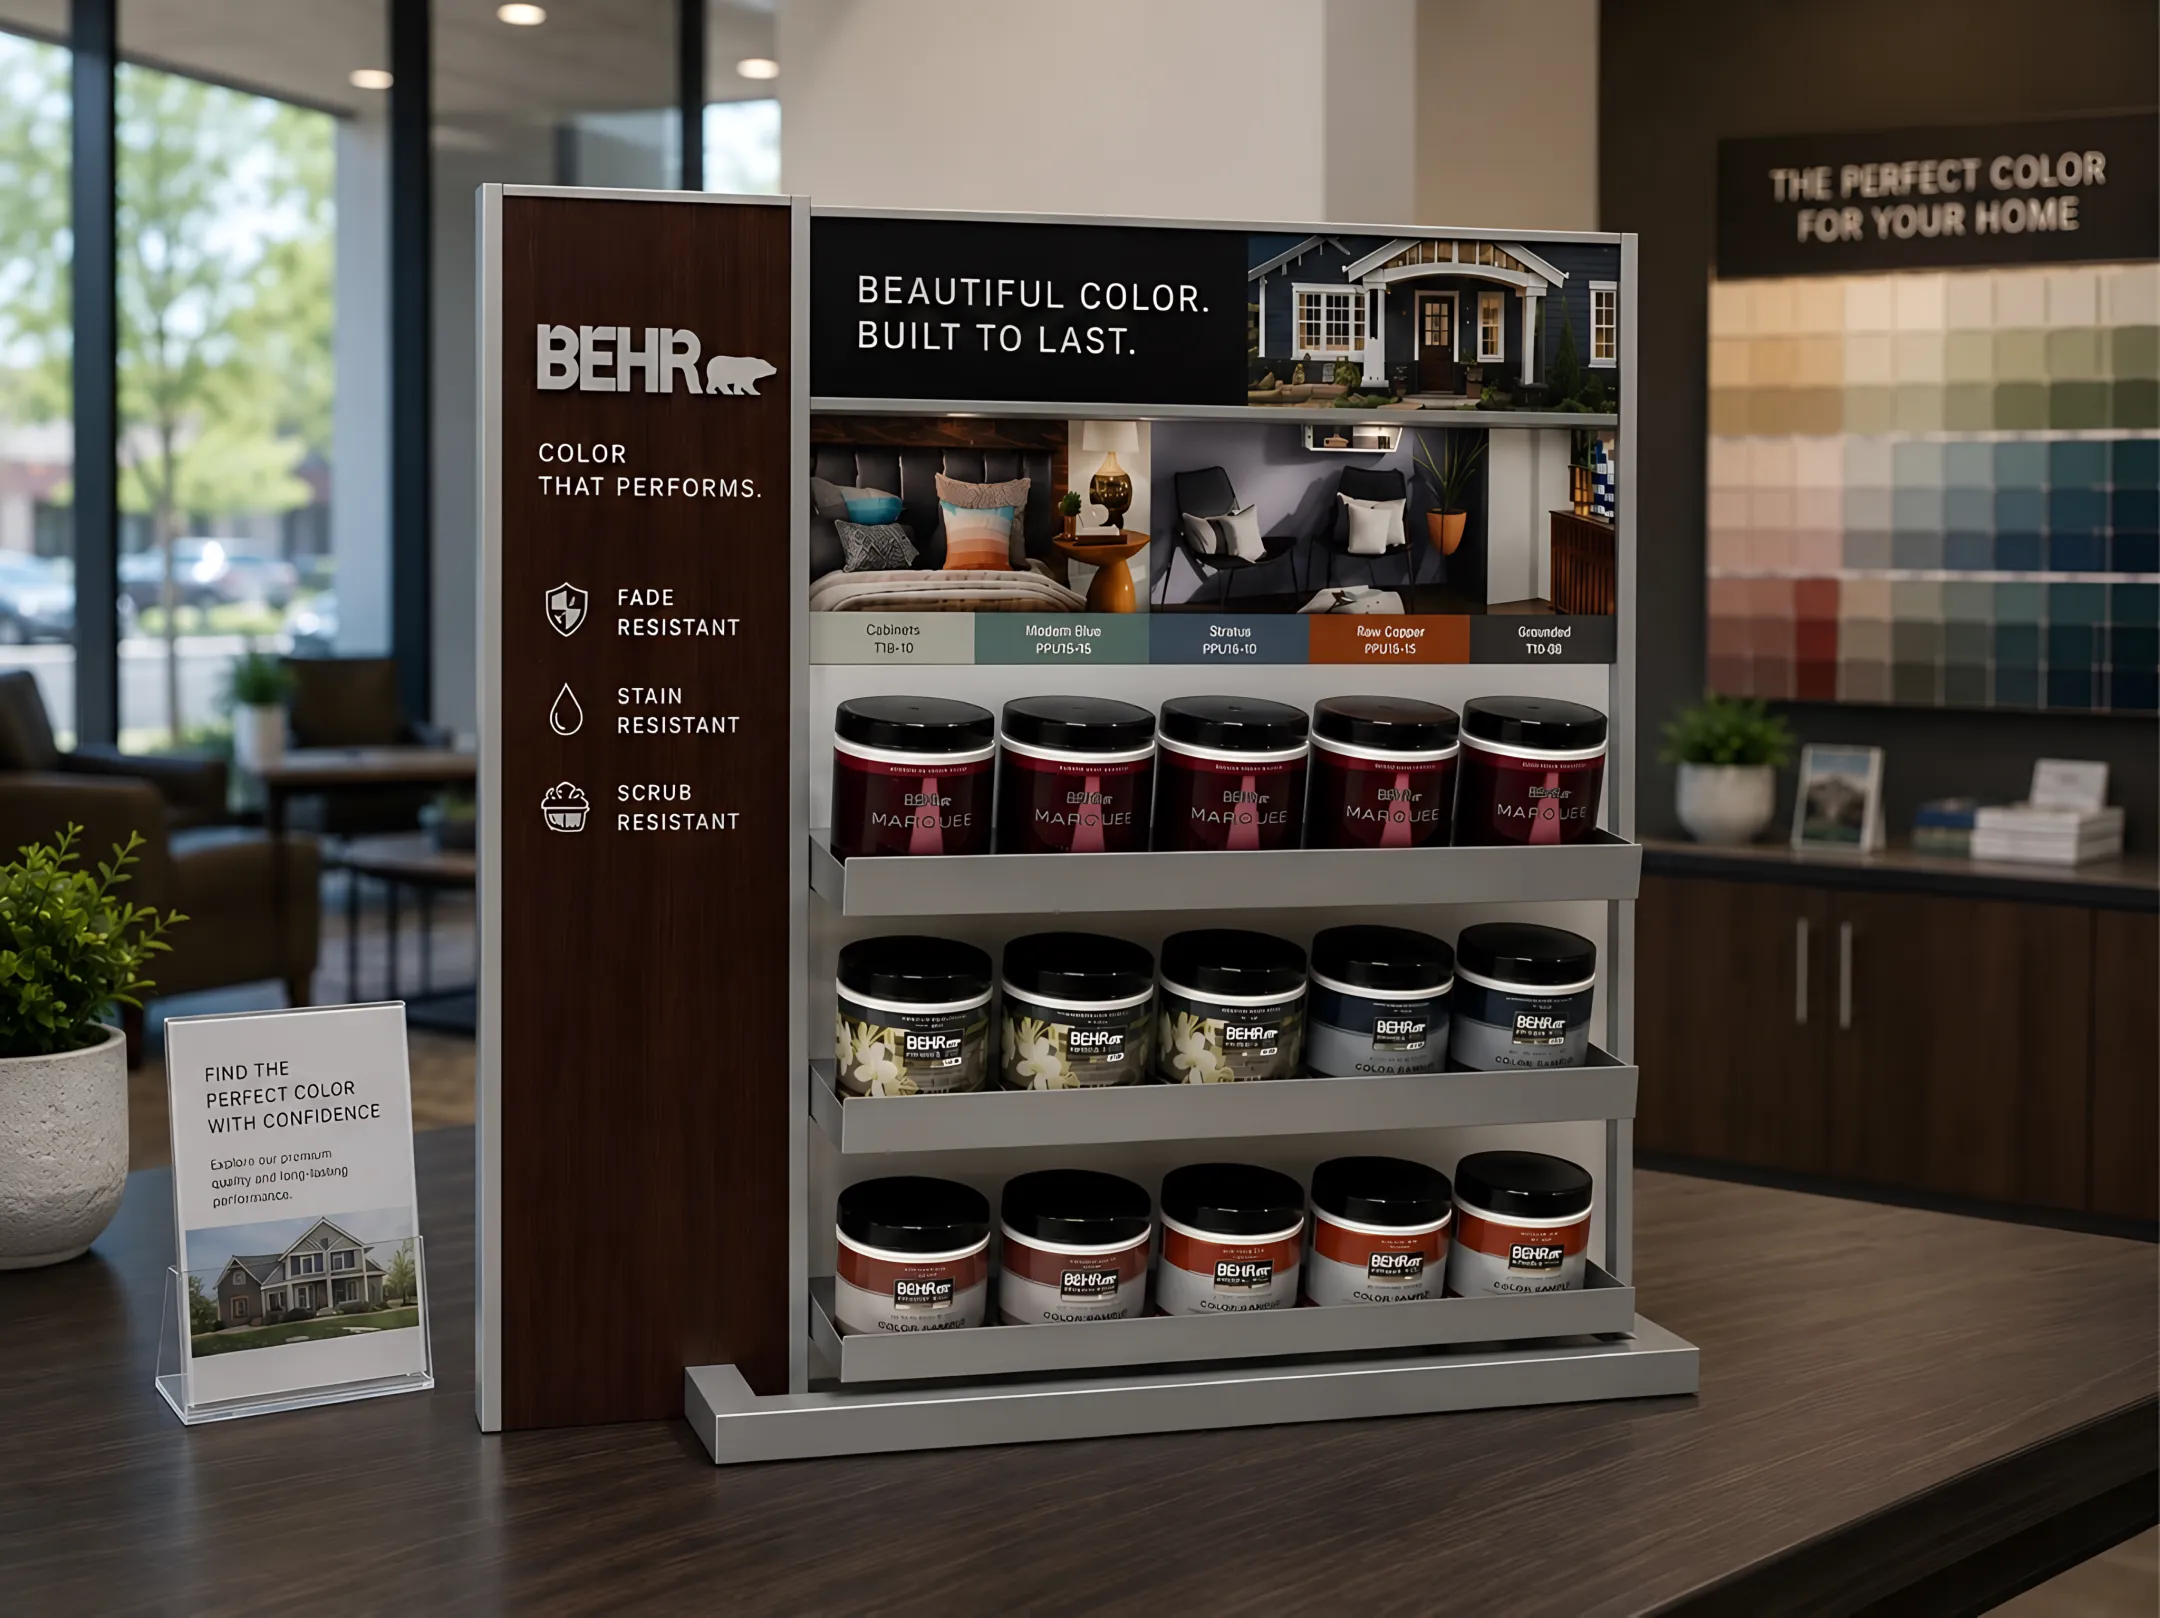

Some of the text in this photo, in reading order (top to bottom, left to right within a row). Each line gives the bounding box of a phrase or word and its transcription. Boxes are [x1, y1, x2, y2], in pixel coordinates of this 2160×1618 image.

[1768, 151, 2106, 202] THE PERFECT COLOR
[1797, 195, 2080, 243] FOR YOUR HOME
[859, 275, 1210, 312] BEAUTIFUL COLOR.
[859, 320, 1136, 355] BUILT TO LAST.
[538, 324, 703, 394] BEHR
[539, 442, 626, 464] COLOR
[539, 476, 762, 498] THAT PERFORMS.
[618, 589, 674, 606] FADE
[618, 619, 740, 636] RESISTANT
[618, 688, 682, 704] STAIN
[618, 716, 740, 734] RESISTANT
[618, 784, 691, 801] SCRUB
[618, 813, 740, 830] RESISTANT
[907, 1036, 945, 1049] BEHR
[1071, 1032, 1109, 1045] BEHR
[1227, 1027, 1263, 1040] BEHR
[206, 1061, 289, 1082] FIND THE
[207, 1081, 354, 1108] PERFECT COLOR
[208, 1103, 380, 1133] WITH CONFIDENCE
[259, 1156, 277, 1165] our
[255, 1173, 276, 1184] and
